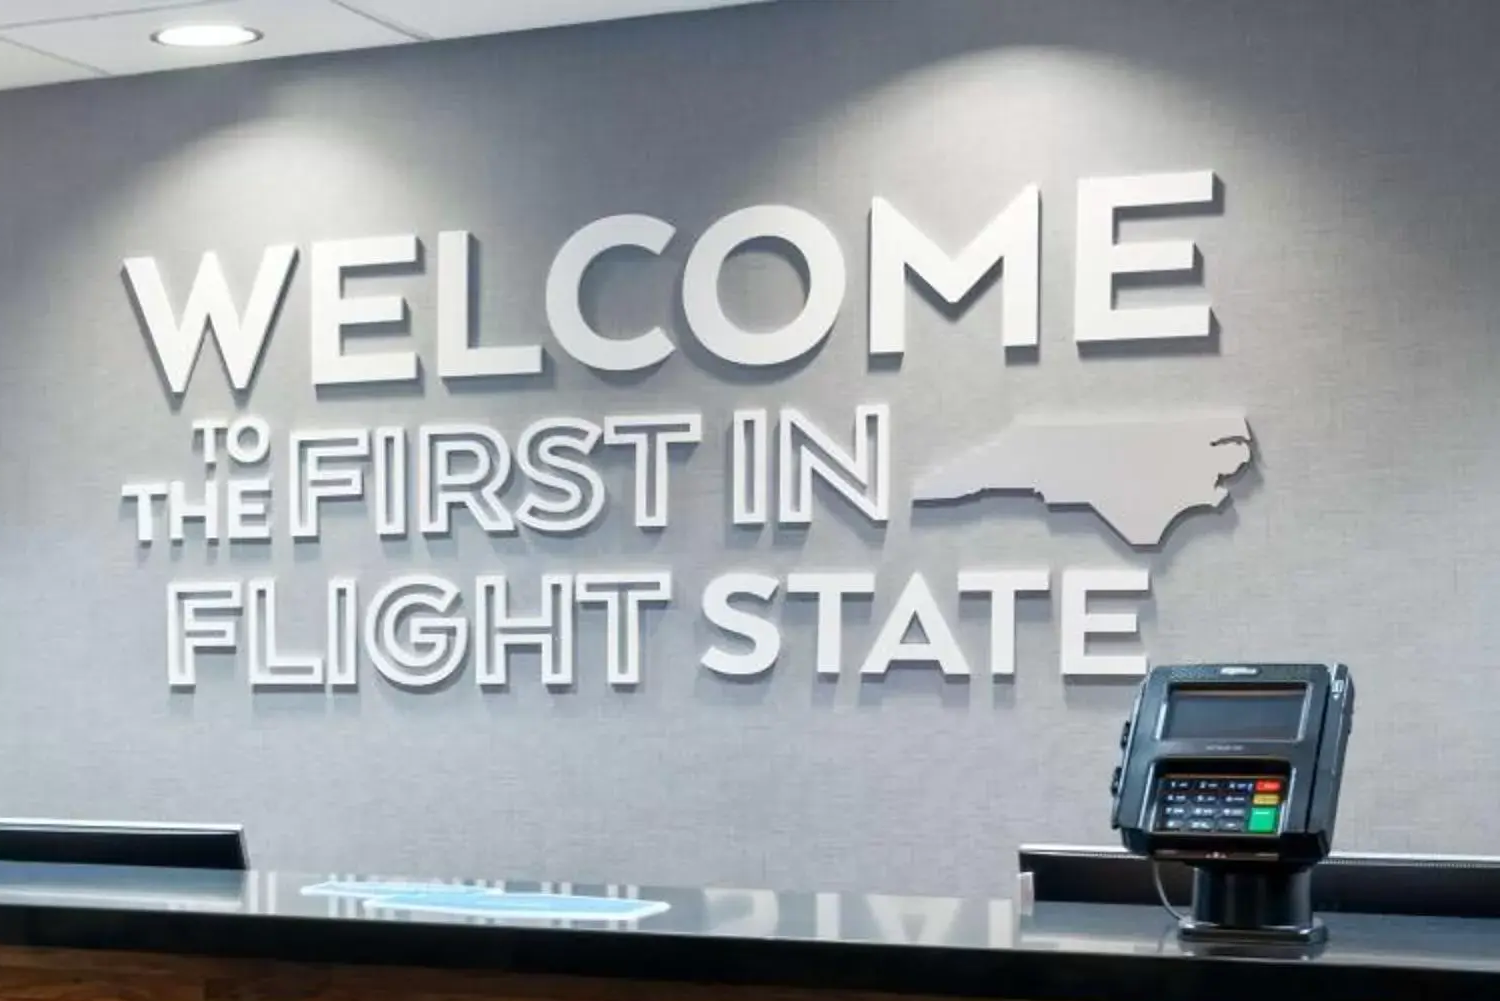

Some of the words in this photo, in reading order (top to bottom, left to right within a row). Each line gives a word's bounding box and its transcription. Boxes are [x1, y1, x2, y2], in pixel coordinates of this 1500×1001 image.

[121, 170, 1216, 393] WELCOME
[192, 415, 270, 464] TO
[289, 413, 702, 537] FIRST
[733, 404, 889, 526] IN
[121, 477, 272, 543] THE
[167, 571, 672, 686] FLIGHT
[700, 569, 1150, 676] STATE
